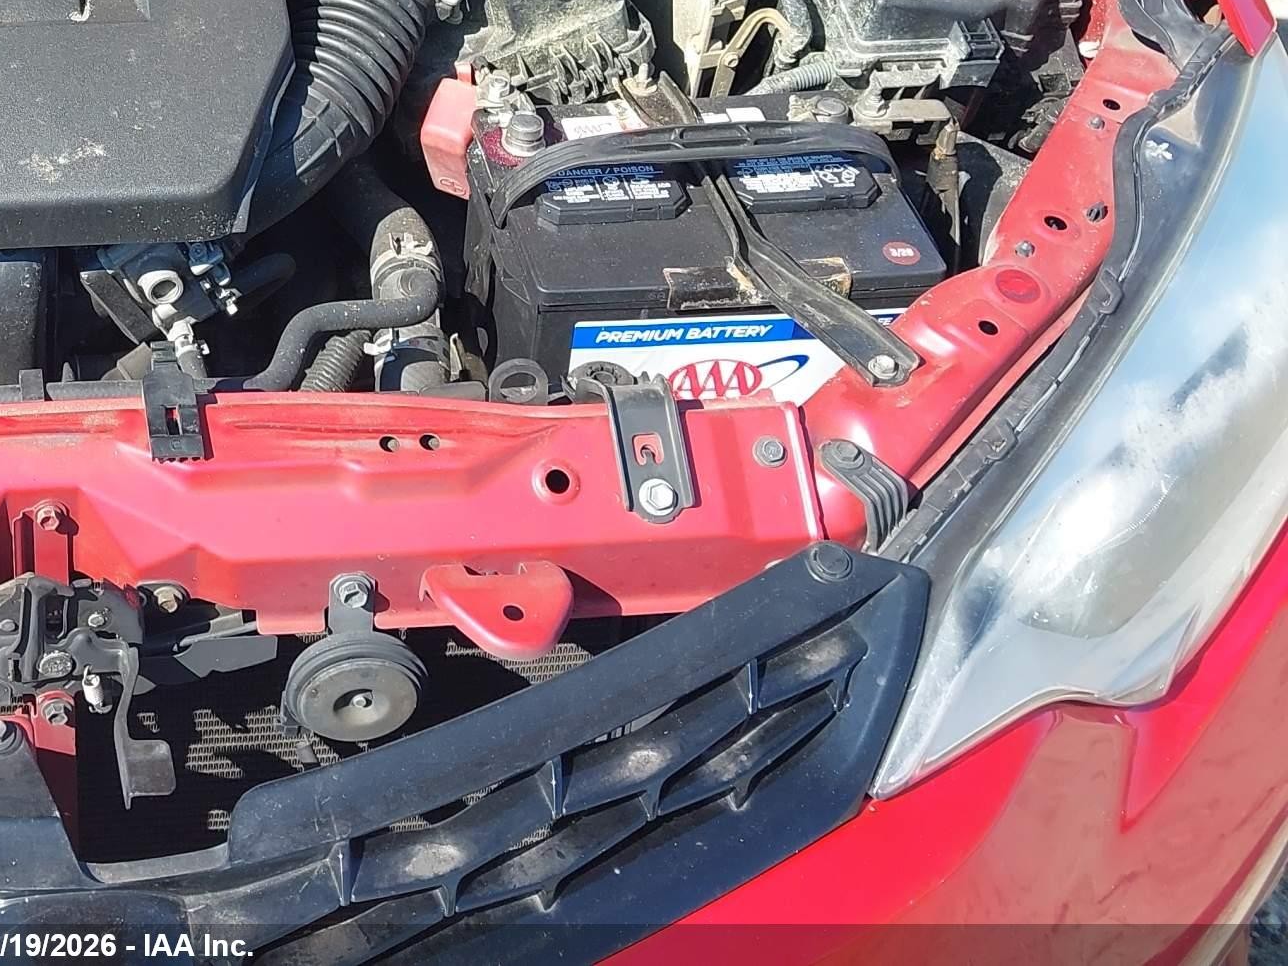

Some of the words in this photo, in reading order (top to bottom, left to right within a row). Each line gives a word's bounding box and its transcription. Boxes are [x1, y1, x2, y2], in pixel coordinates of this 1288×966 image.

[558, 167, 603, 176] DANGER
[613, 165, 654, 174] POISON
[595, 327, 683, 344] PREMIUM
[685, 324, 773, 340] BATTERY
[669, 360, 760, 398] AAA
